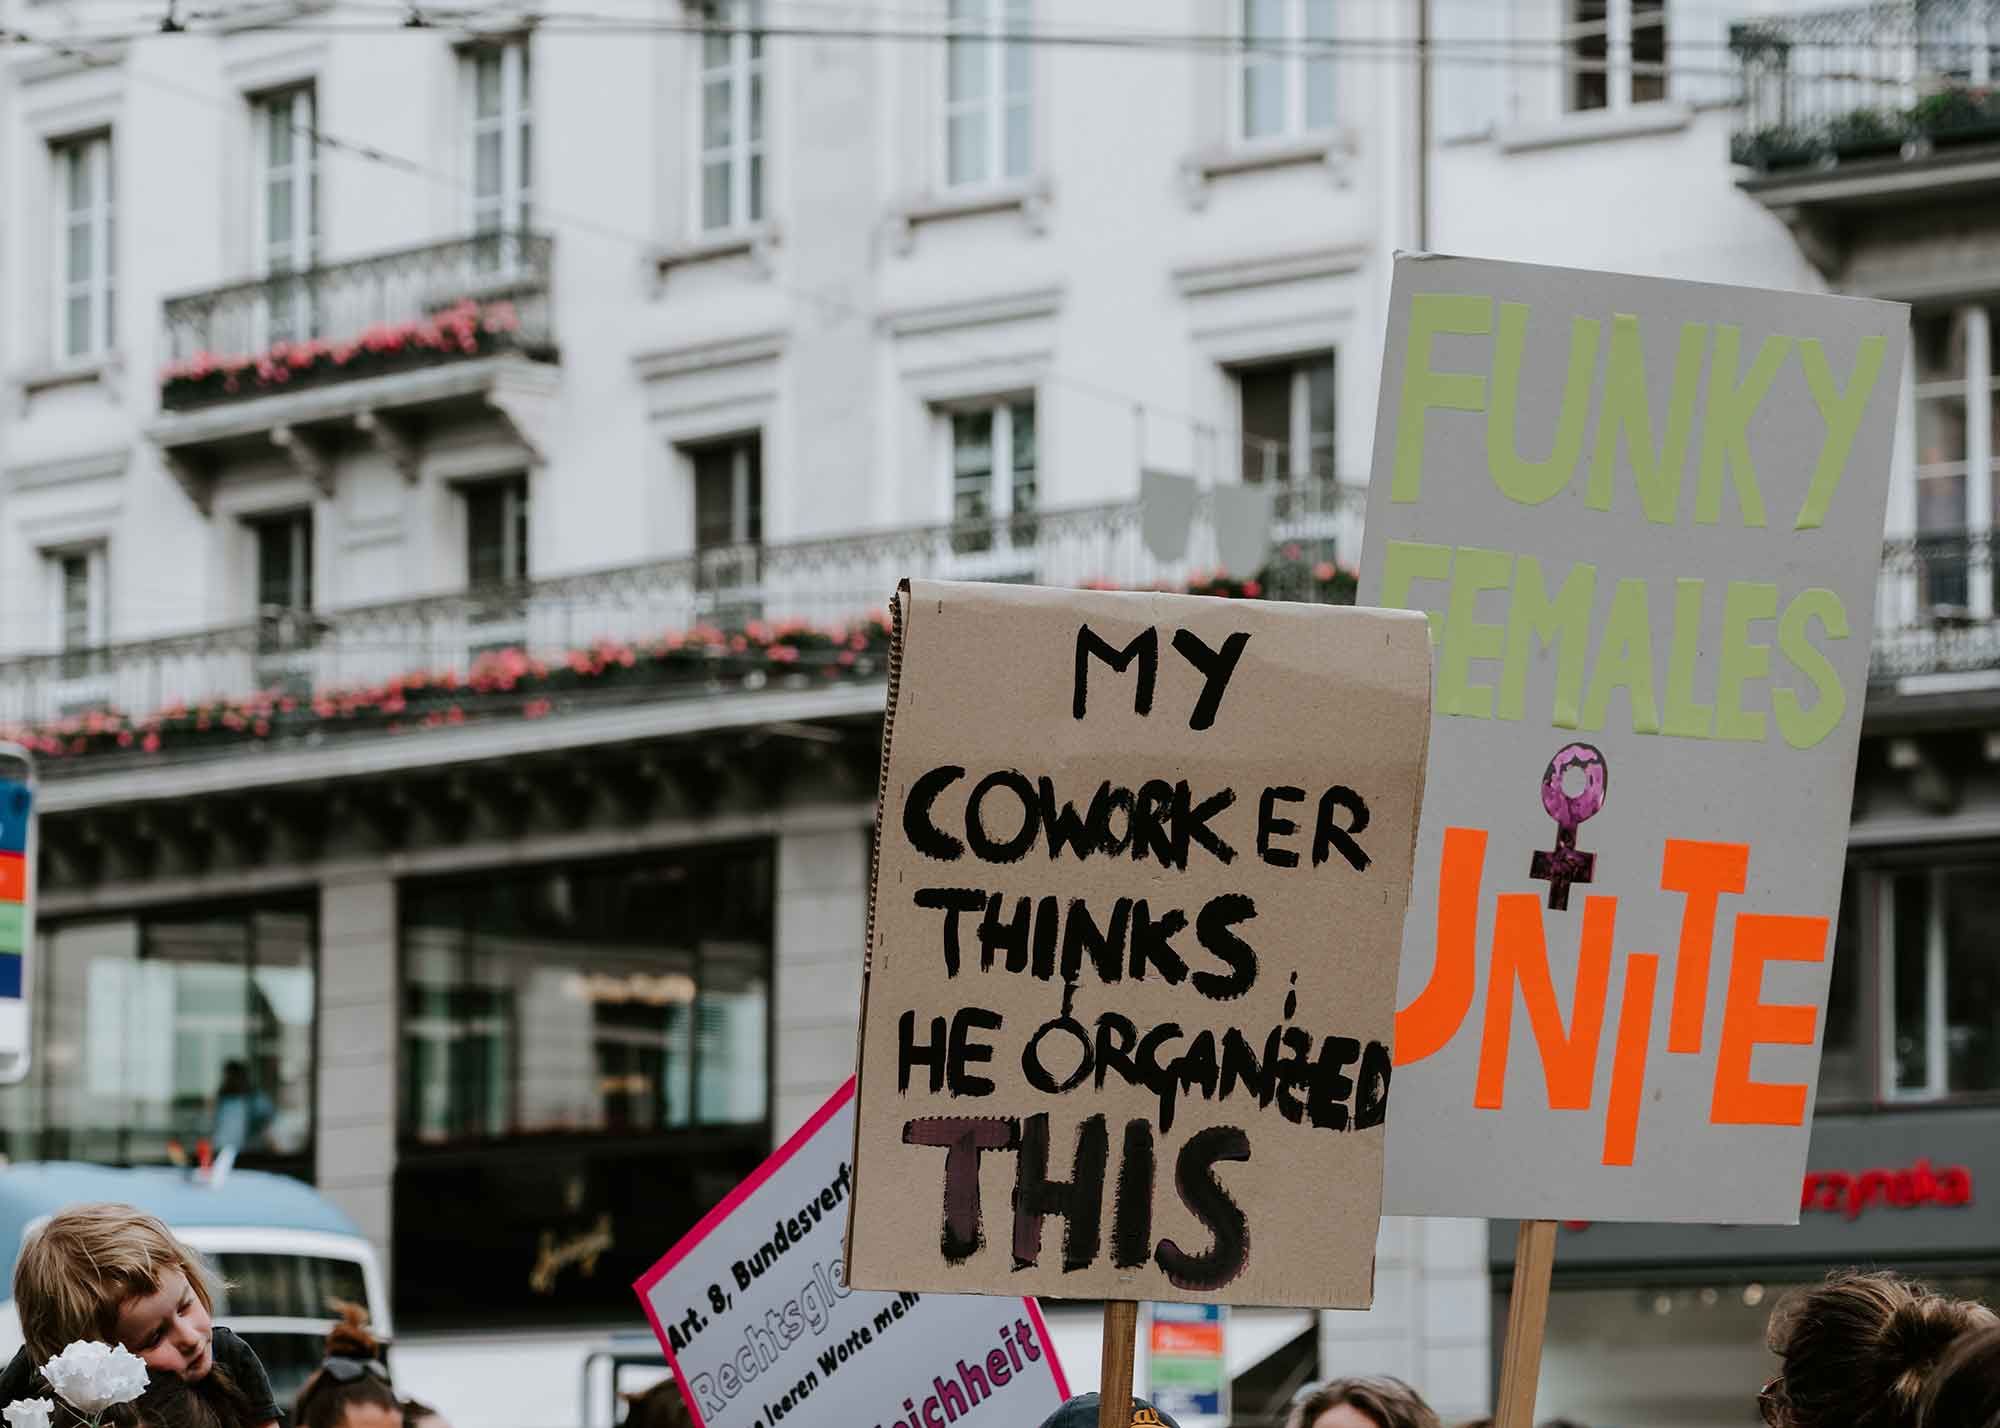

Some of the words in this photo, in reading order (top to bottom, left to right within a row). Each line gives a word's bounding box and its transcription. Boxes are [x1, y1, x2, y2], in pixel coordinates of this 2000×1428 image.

[1392, 294, 1888, 530] FUNKY
[1073, 624, 1252, 731] MY
[1380, 539, 1849, 749] FEMALES
[903, 765, 1372, 872] COWORKER
[913, 888, 1258, 1001] THINKS
[1392, 827, 1830, 1167] UNITE
[898, 1007, 1003, 1096] HE
[667, 1308, 709, 1356] Art.
[707, 1283, 733, 1316] 8,
[731, 1161, 852, 1292] Bundesverf
[902, 1112, 1251, 1291] THIS
[690, 1258, 853, 1423] Rechtsgle
[763, 1371, 819, 1427] leeren
[817, 1326, 873, 1377] Worte
